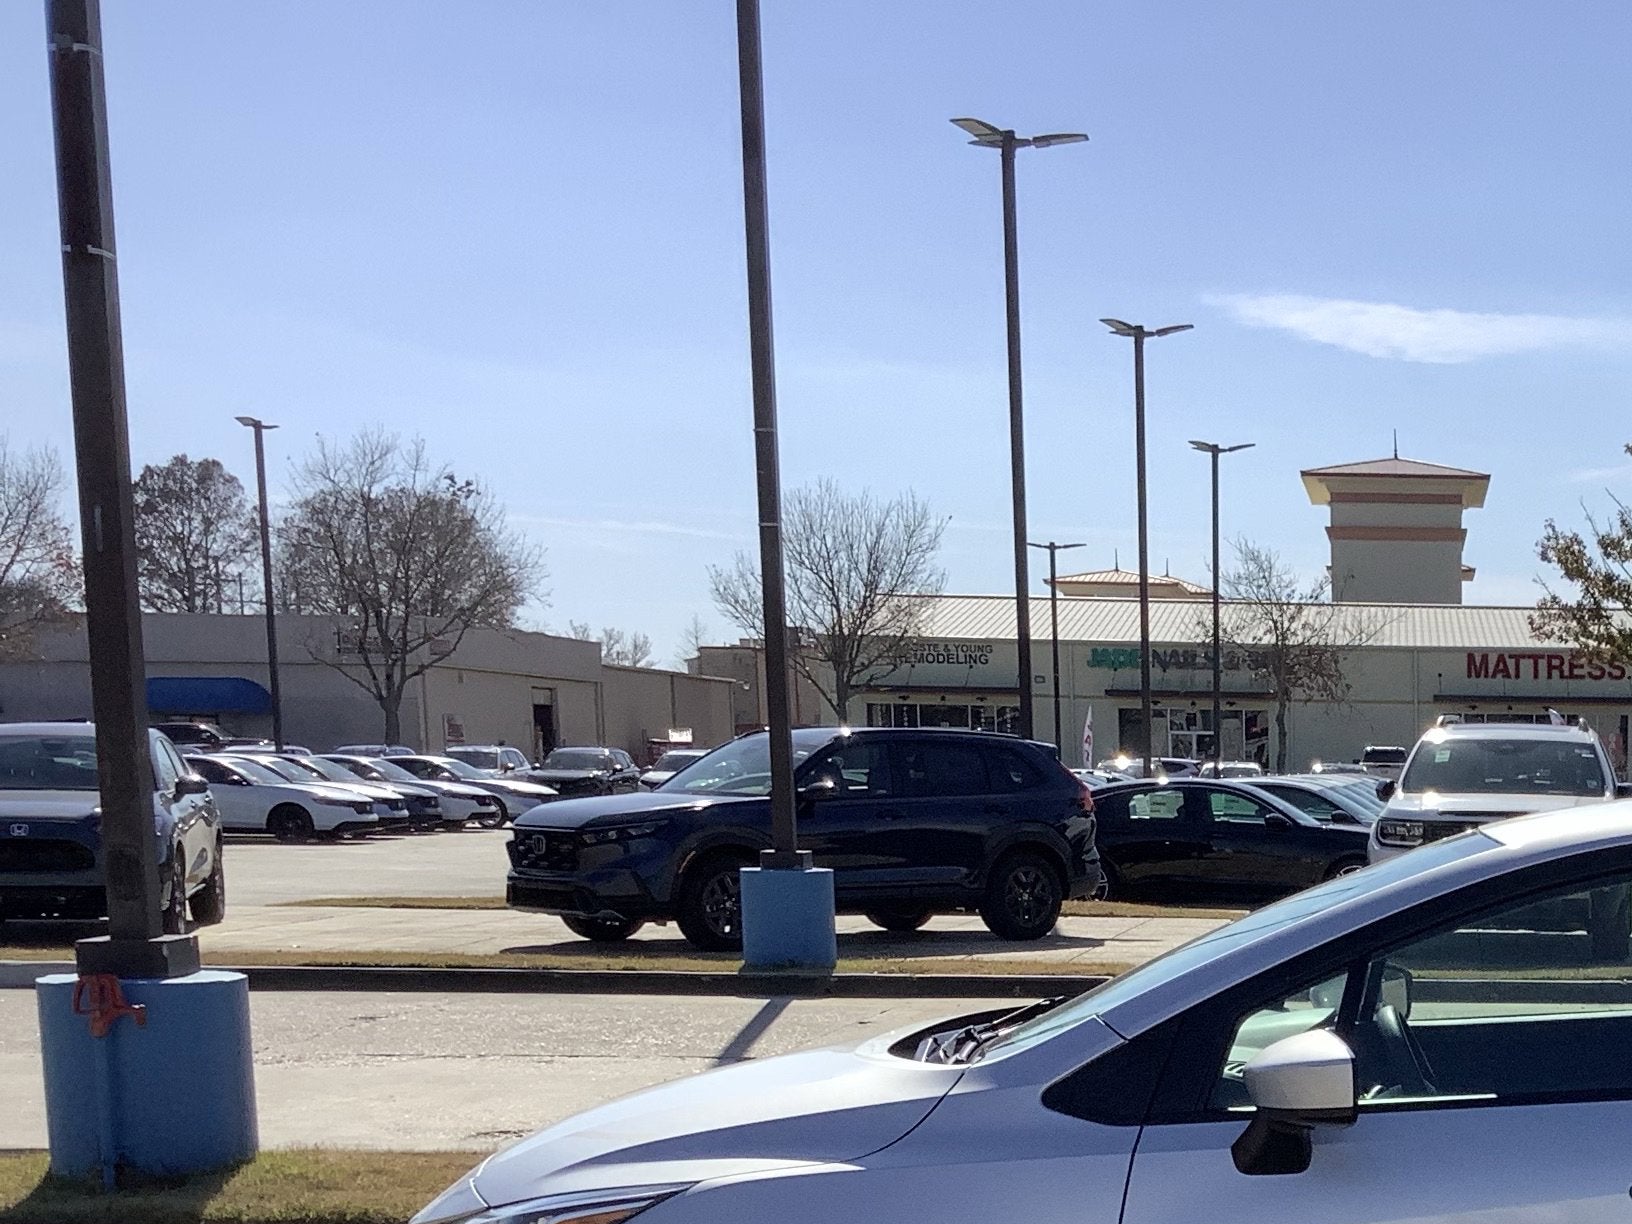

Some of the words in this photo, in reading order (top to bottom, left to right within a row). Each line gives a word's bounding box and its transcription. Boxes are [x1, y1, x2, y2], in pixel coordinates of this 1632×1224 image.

[943, 644, 950, 652] &
[953, 644, 993, 654] YOUNG
[1466, 653, 1626, 680] MATTRESS
